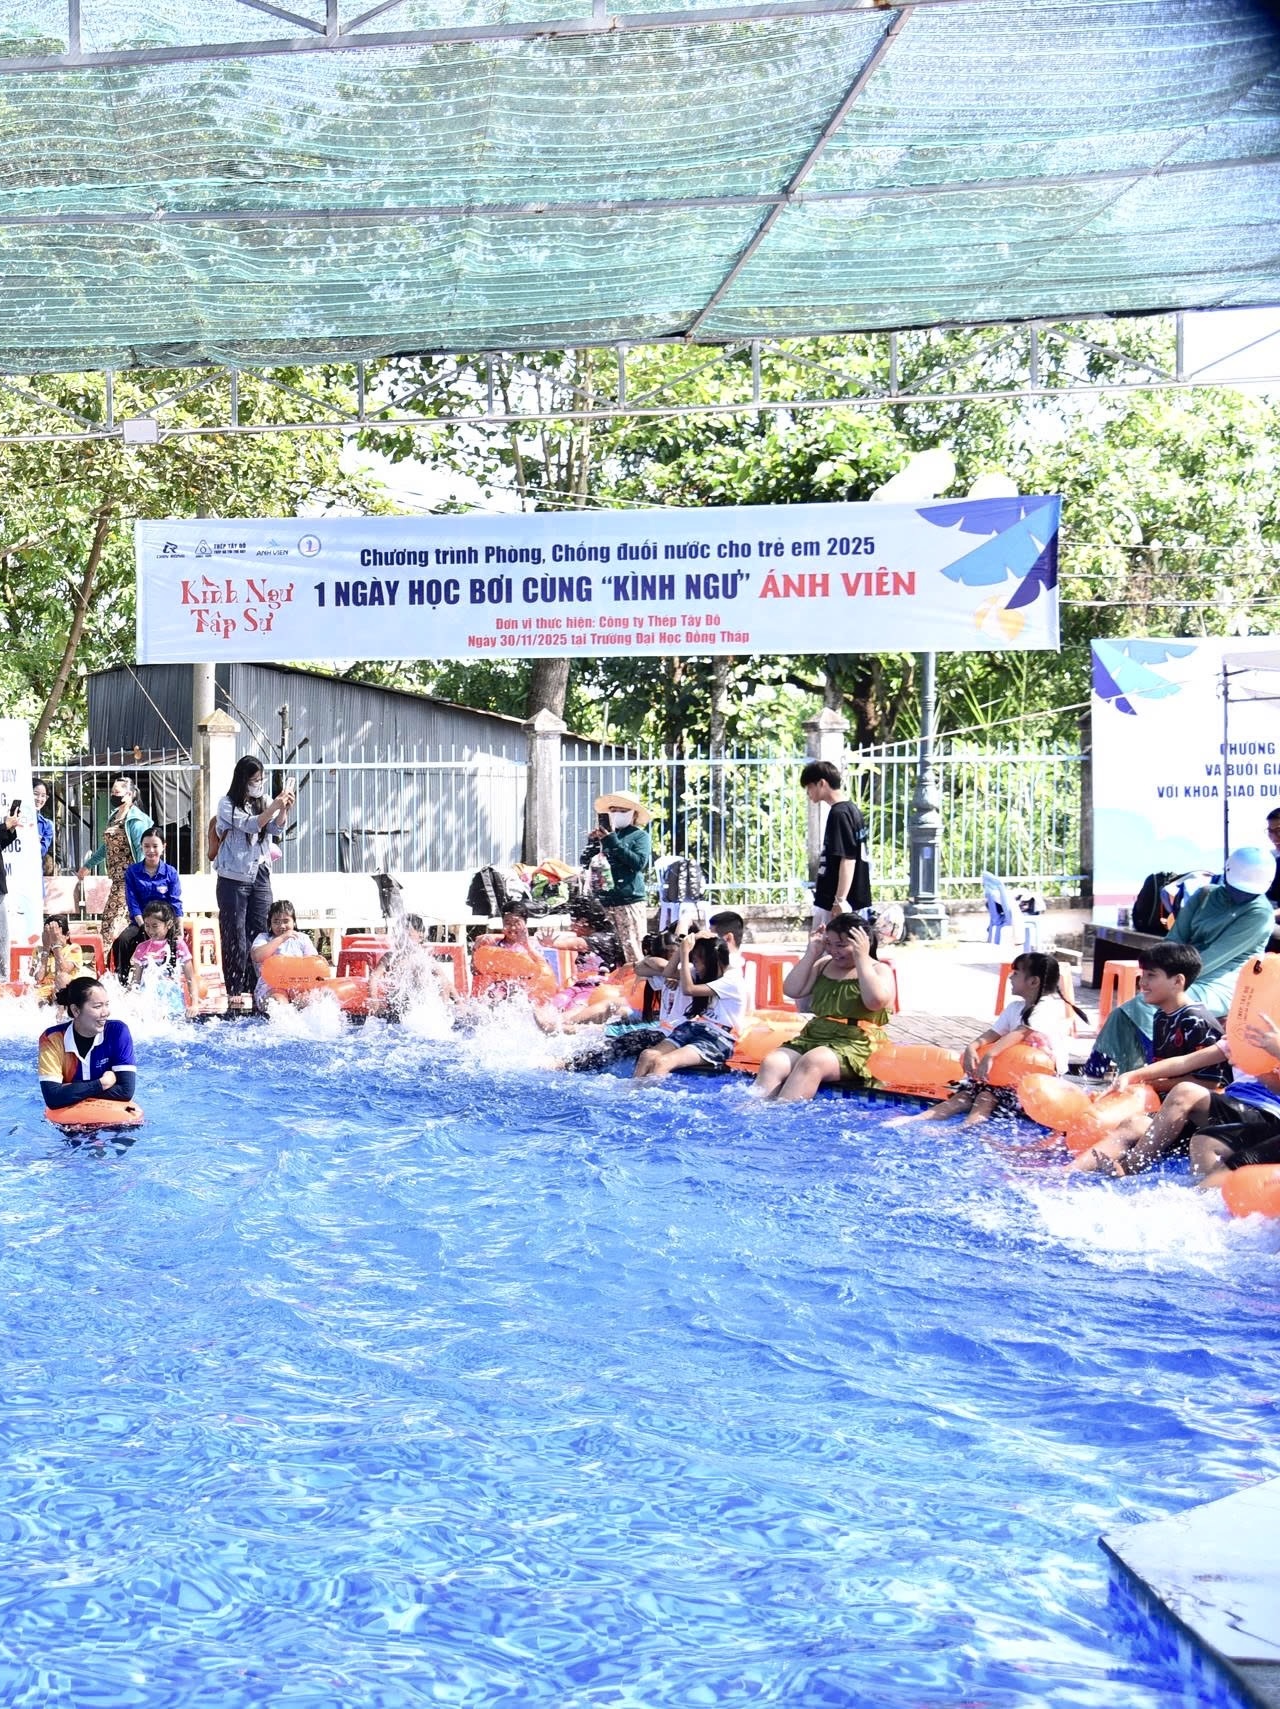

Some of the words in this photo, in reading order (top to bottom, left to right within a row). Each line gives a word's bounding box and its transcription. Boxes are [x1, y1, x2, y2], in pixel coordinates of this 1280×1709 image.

[360, 548, 429, 567] Chương
[435, 546, 478, 564] trình
[485, 544, 546, 565] Phòng,
[552, 541, 610, 563] Chống
[617, 539, 657, 560] đuối
[664, 538, 710, 559] nước
[717, 540, 752, 558] cho
[758, 537, 784, 557] trẻ
[791, 541, 820, 556] em
[827, 536, 875, 556] 2025
[180, 574, 239, 604] Kình
[245, 578, 294, 610] Ngư
[314, 582, 325, 607] 1
[335, 577, 400, 607] NGÀY
[409, 579, 460, 610] HỌC
[469, 574, 512, 604] BƠI
[522, 572, 592, 603] CÙNG
[758, 569, 830, 598] ÁNH
[841, 566, 916, 597] VIÊN
[190, 608, 237, 639] Tập
[243, 607, 274, 635] Sự
[496, 618, 518, 630] Đơn
[500, 634, 567, 646] 30/11/2025
